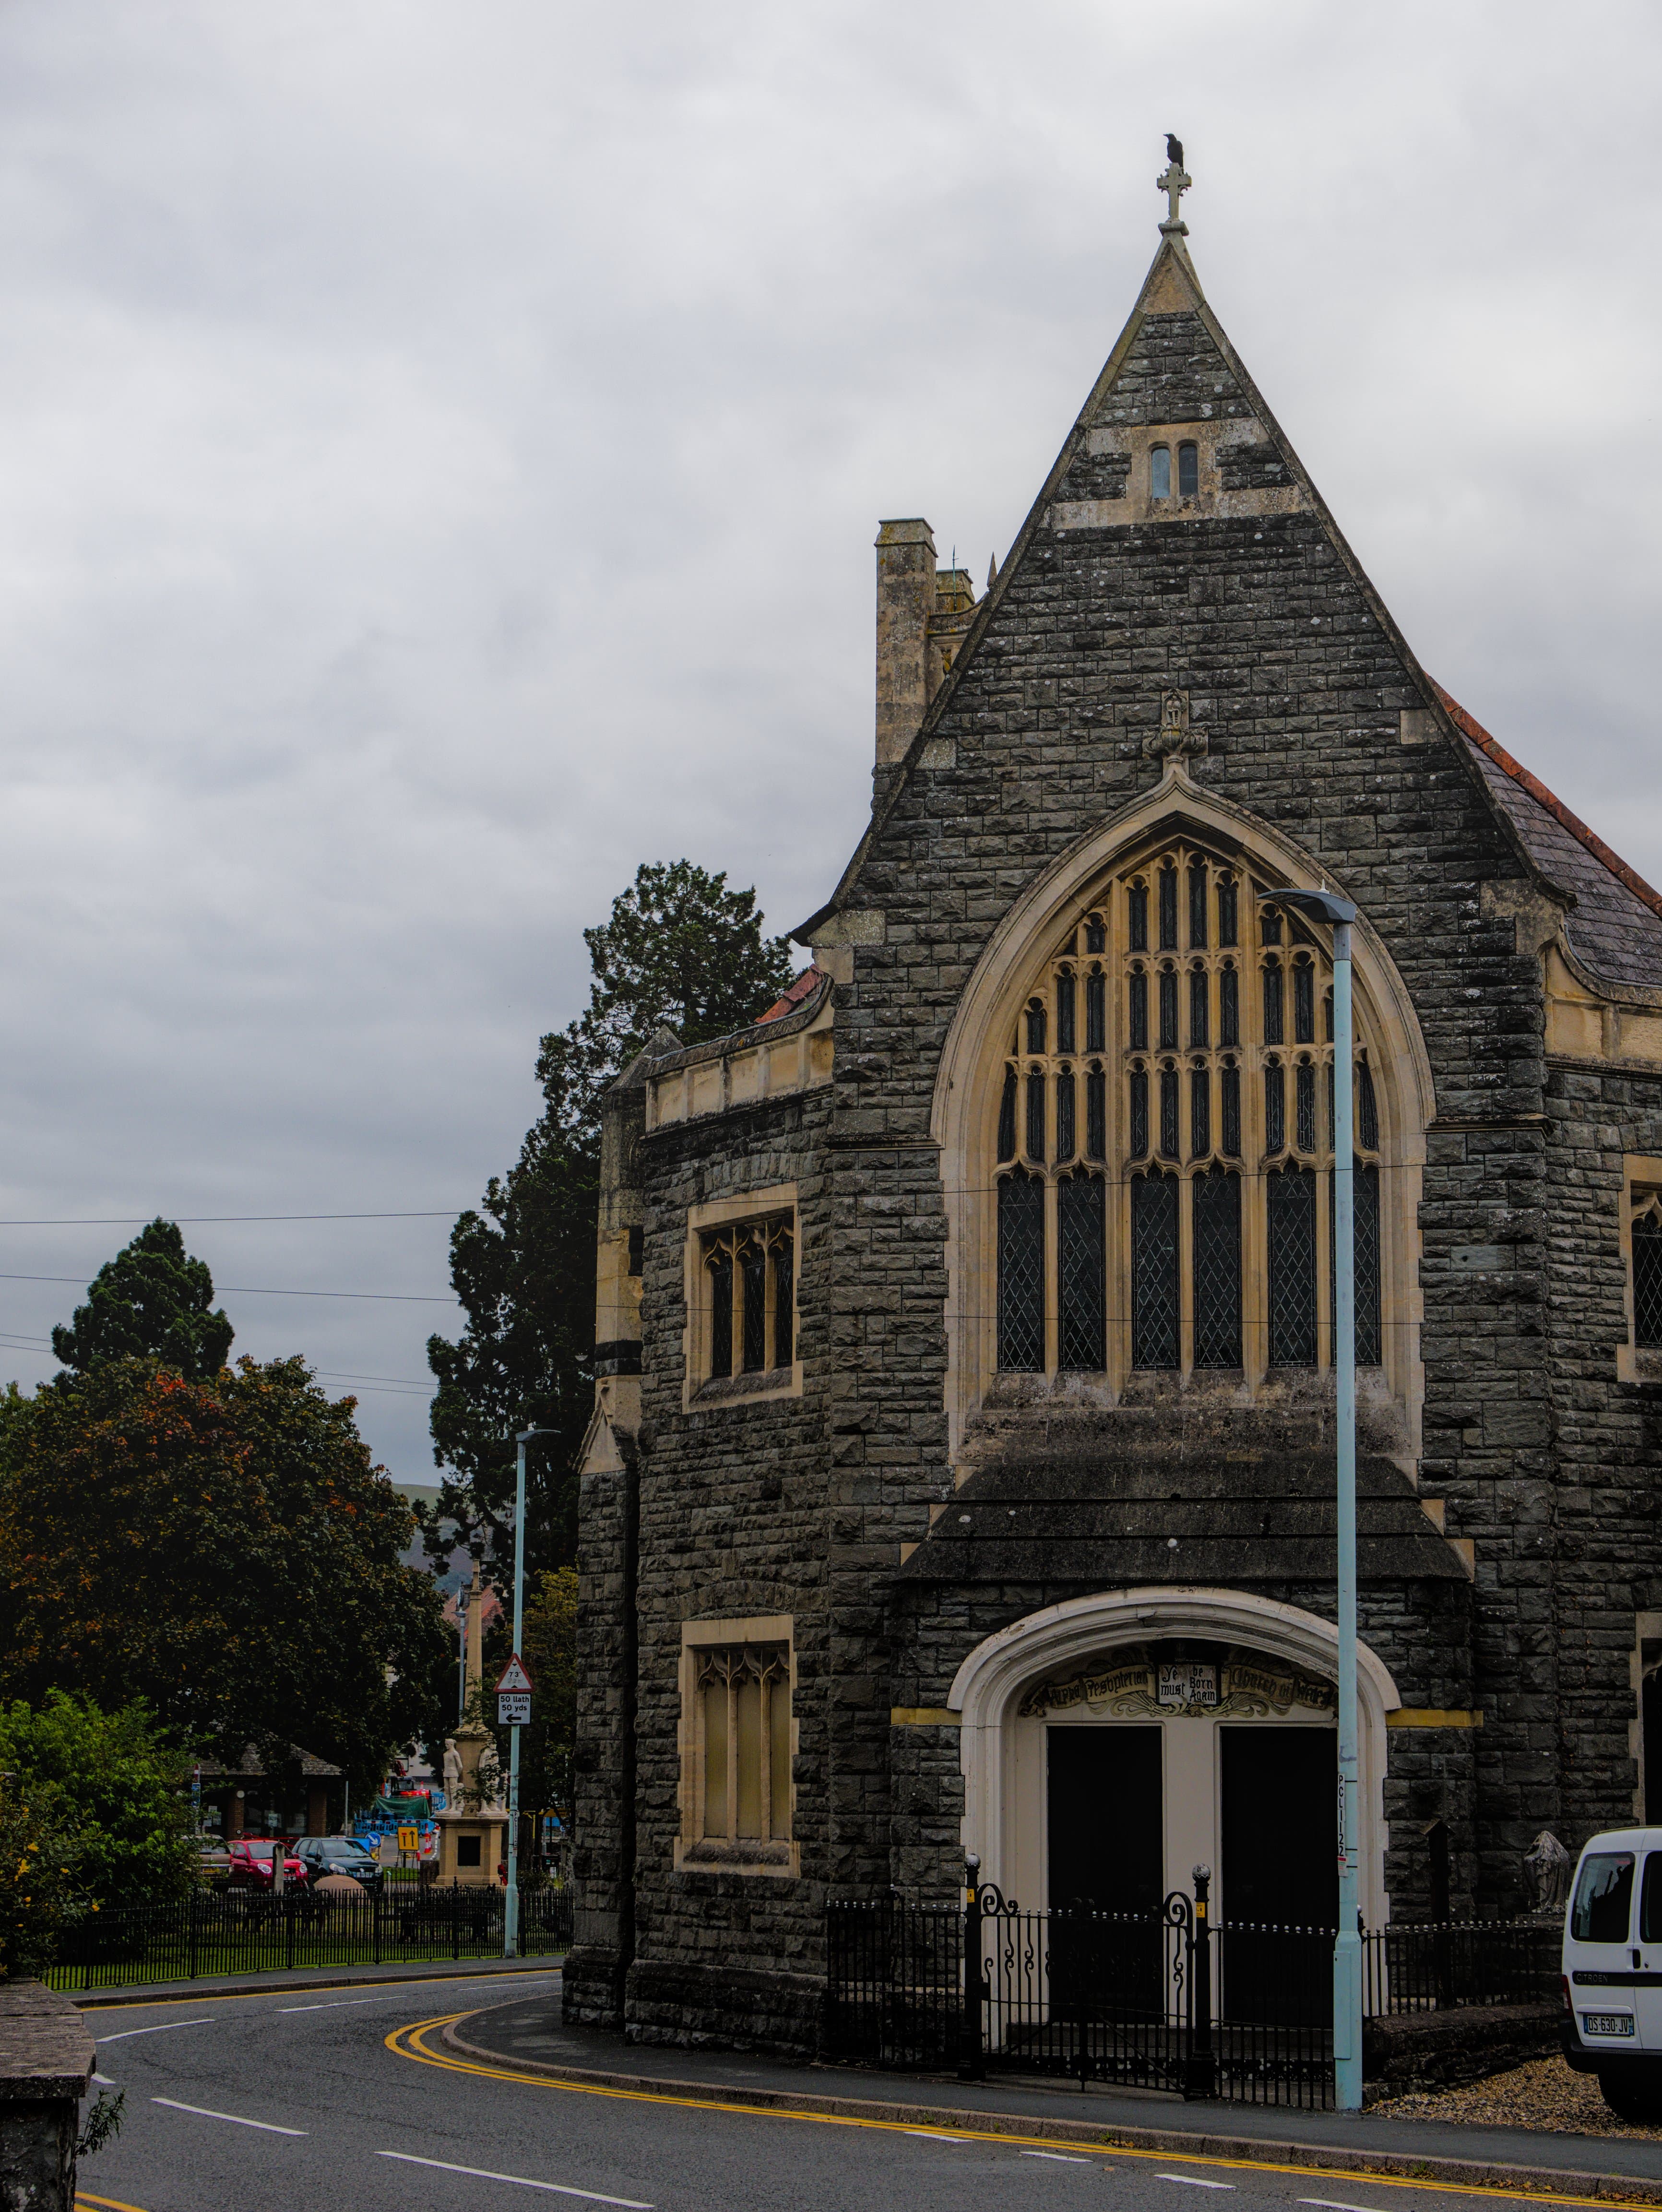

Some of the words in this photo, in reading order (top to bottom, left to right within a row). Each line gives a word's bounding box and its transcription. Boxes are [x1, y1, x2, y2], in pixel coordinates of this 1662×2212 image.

[1162, 1665, 1178, 1682] Ye
[1193, 1665, 1203, 1677] be
[1161, 1682, 1186, 1695] must
[1189, 1677, 1213, 1689] Born
[1189, 1689, 1215, 1702] Again
